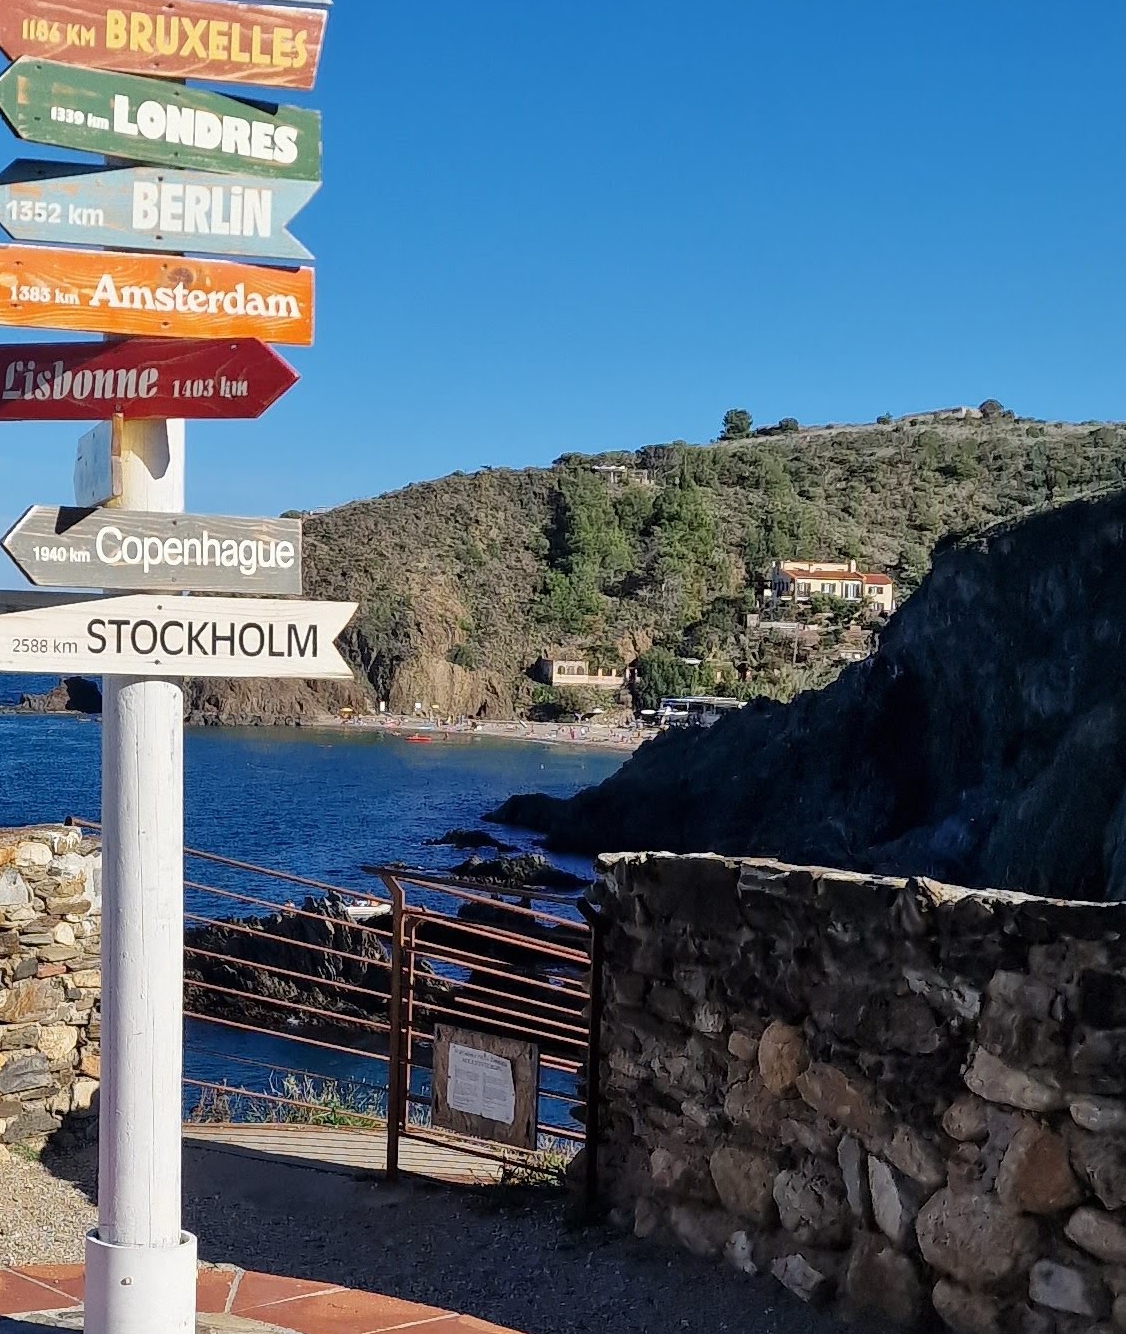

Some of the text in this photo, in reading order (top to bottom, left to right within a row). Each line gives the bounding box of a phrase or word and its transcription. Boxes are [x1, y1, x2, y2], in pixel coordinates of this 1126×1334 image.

[22, 9, 308, 68] 1186 KM BRUXELLES
[86, 112, 110, 131] km
[113, 94, 299, 164] LONDRES
[6, 200, 61, 224] 1352
[69, 205, 104, 227] km
[54, 287, 80, 305] km
[89, 274, 302, 318] Amsterdam
[1, 360, 249, 401] Lisbonne 1403 km
[32, 526, 295, 575] 1940 km Copenhague
[12, 618, 318, 658] 2588 km STOCKHOLM
